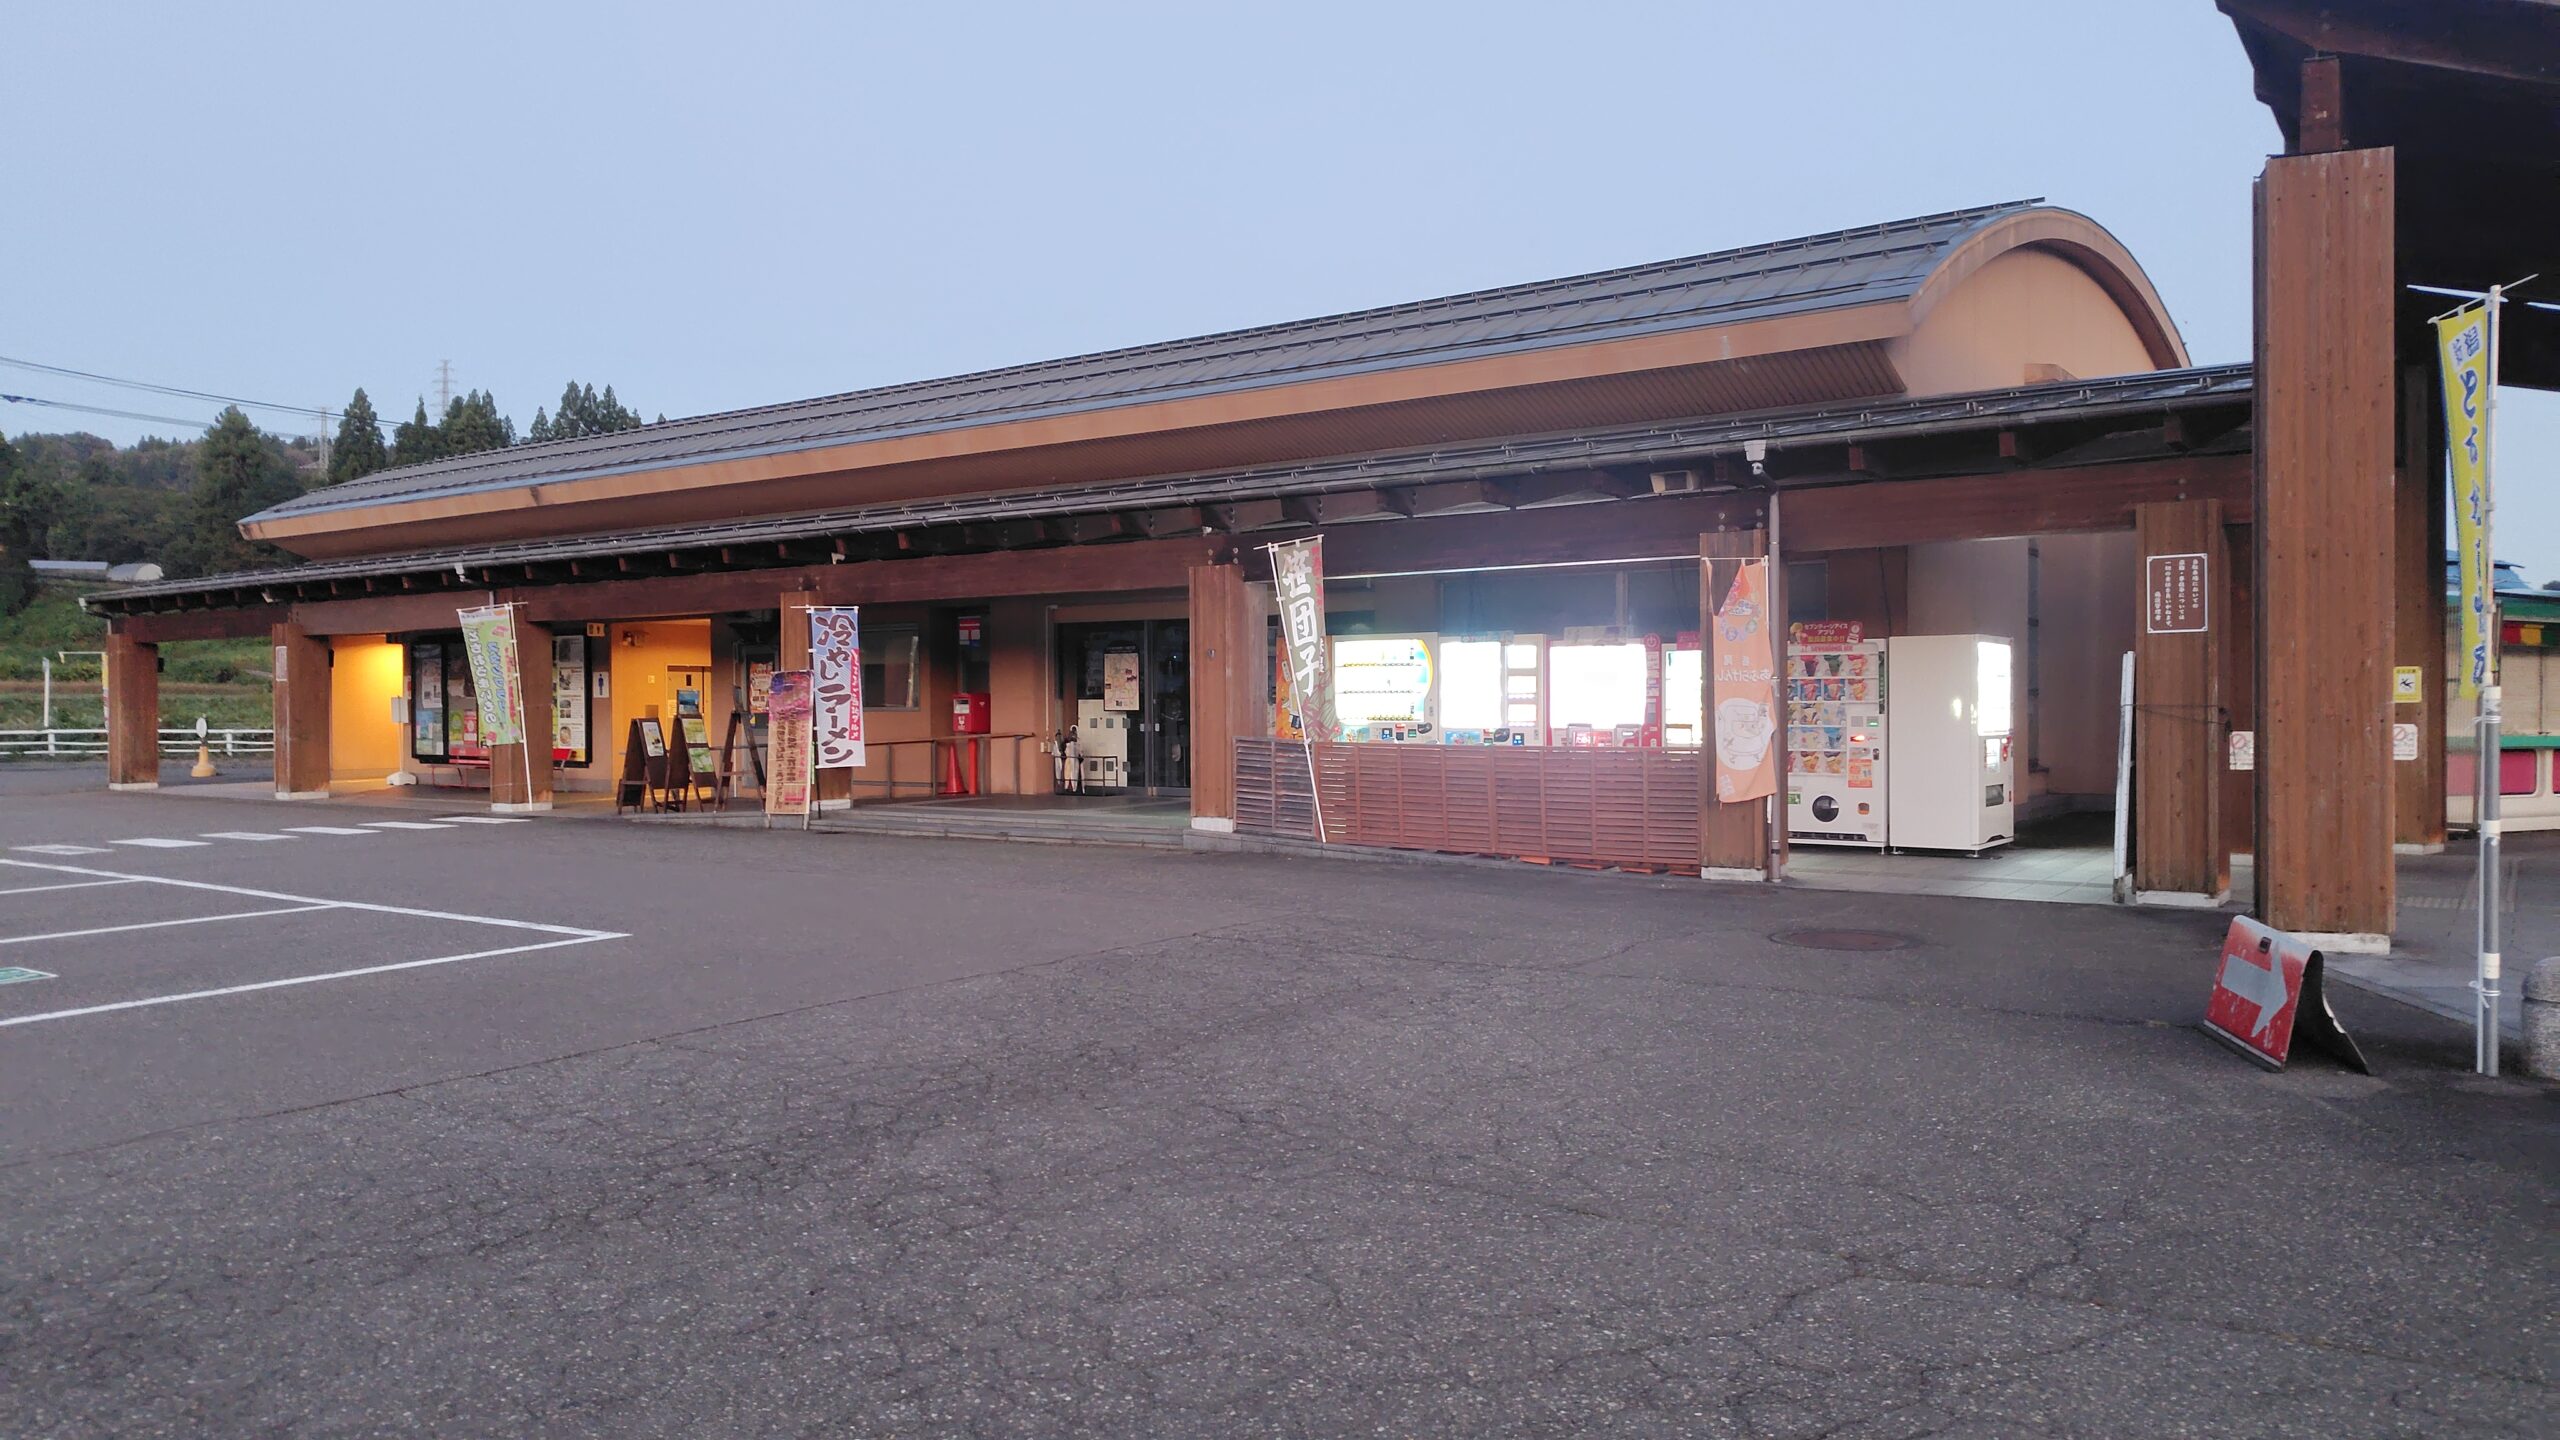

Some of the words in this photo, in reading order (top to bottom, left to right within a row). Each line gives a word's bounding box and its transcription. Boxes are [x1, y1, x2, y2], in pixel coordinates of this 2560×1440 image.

[814, 614, 857, 764] 冷やしラーメン
[1281, 550, 1320, 697] 笹団子
